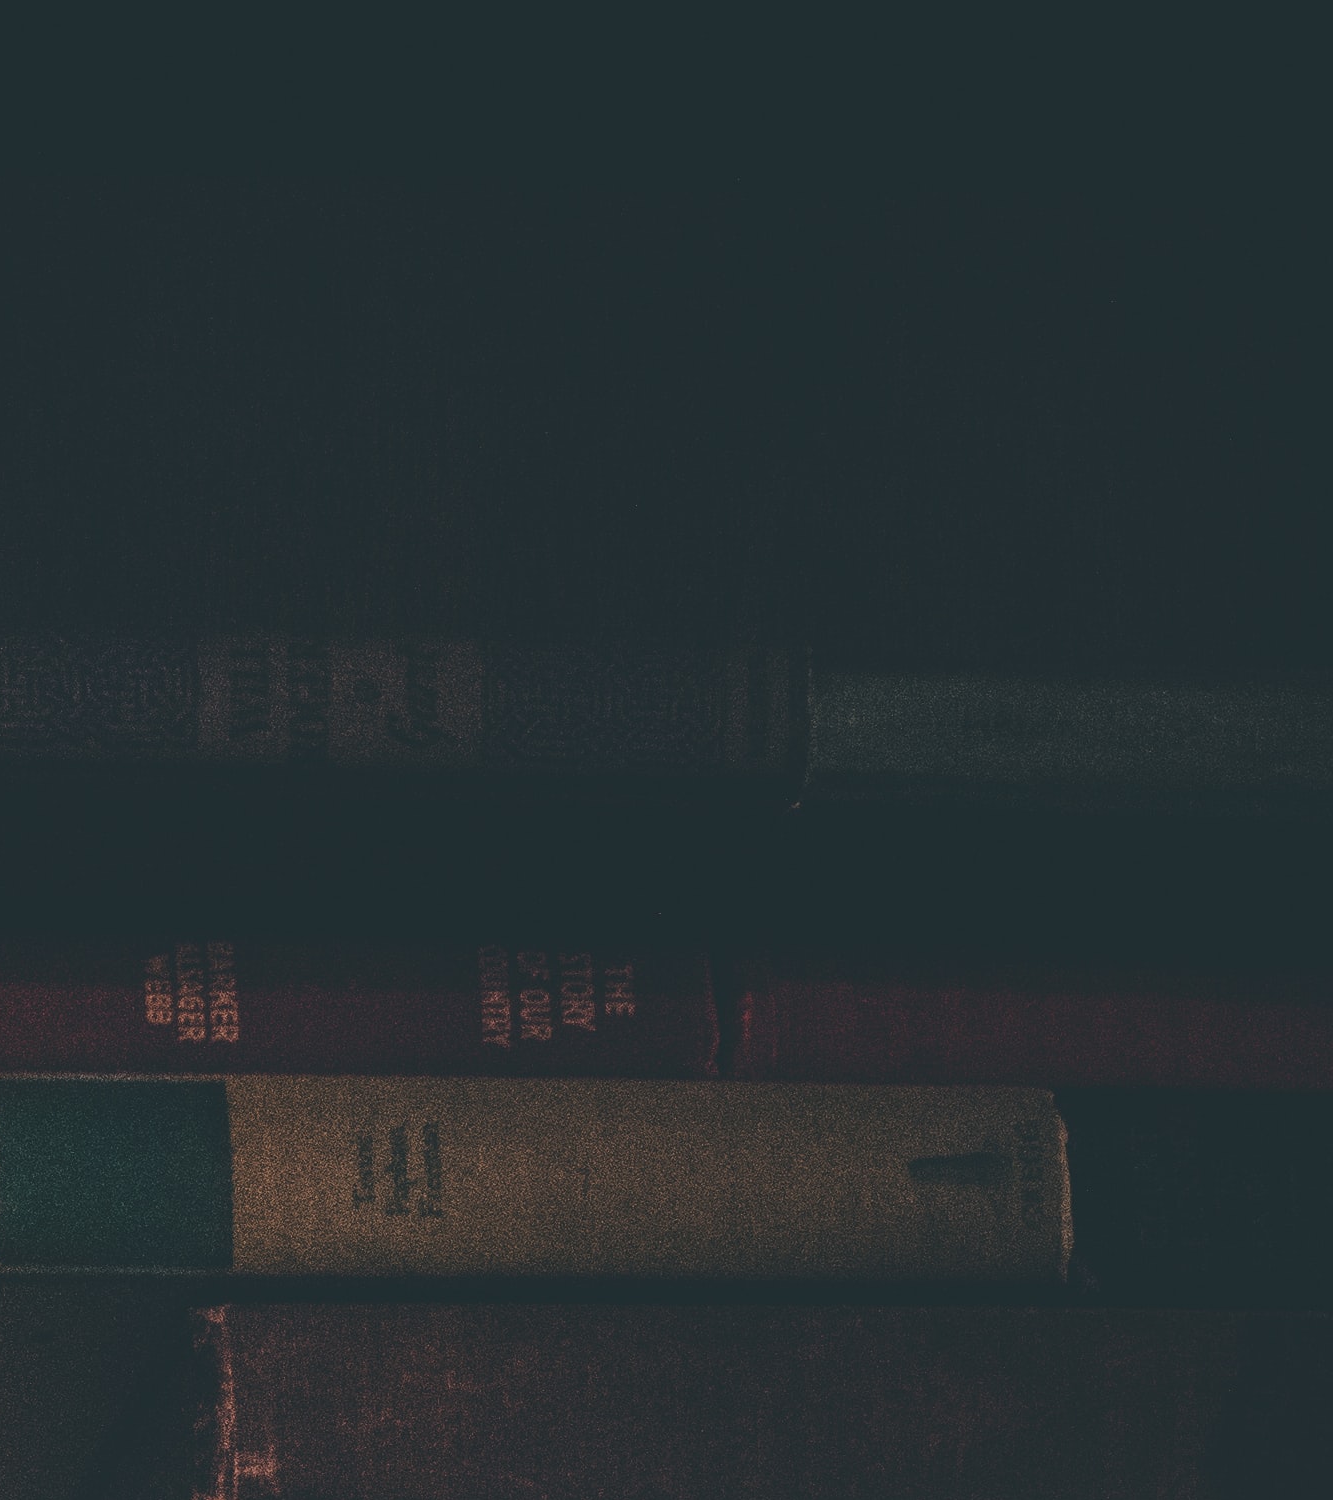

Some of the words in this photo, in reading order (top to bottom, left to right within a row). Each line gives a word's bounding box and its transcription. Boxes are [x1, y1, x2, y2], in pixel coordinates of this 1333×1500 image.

[207, 942, 242, 1043] BARKER
[478, 944, 512, 1048] COUNTRY
[519, 947, 550, 983] OF
[559, 949, 596, 1033] STORY
[604, 963, 636, 1018] THE
[519, 987, 551, 1041] OUR
